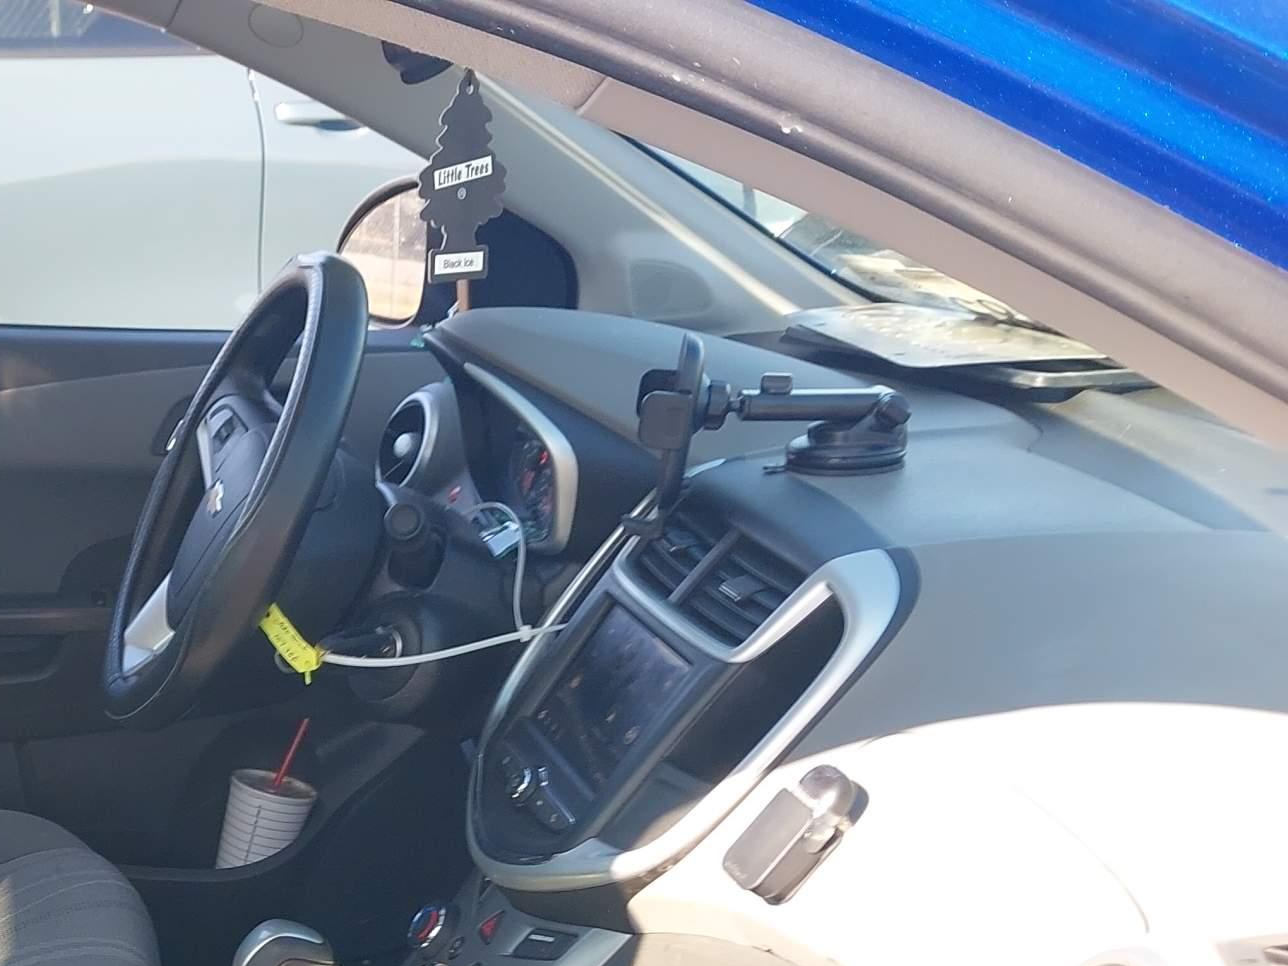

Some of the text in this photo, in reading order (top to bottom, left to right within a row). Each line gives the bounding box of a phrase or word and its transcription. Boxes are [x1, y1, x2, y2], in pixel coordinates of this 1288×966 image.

[438, 162, 489, 186] Little Trees
[443, 258, 462, 269] Black
